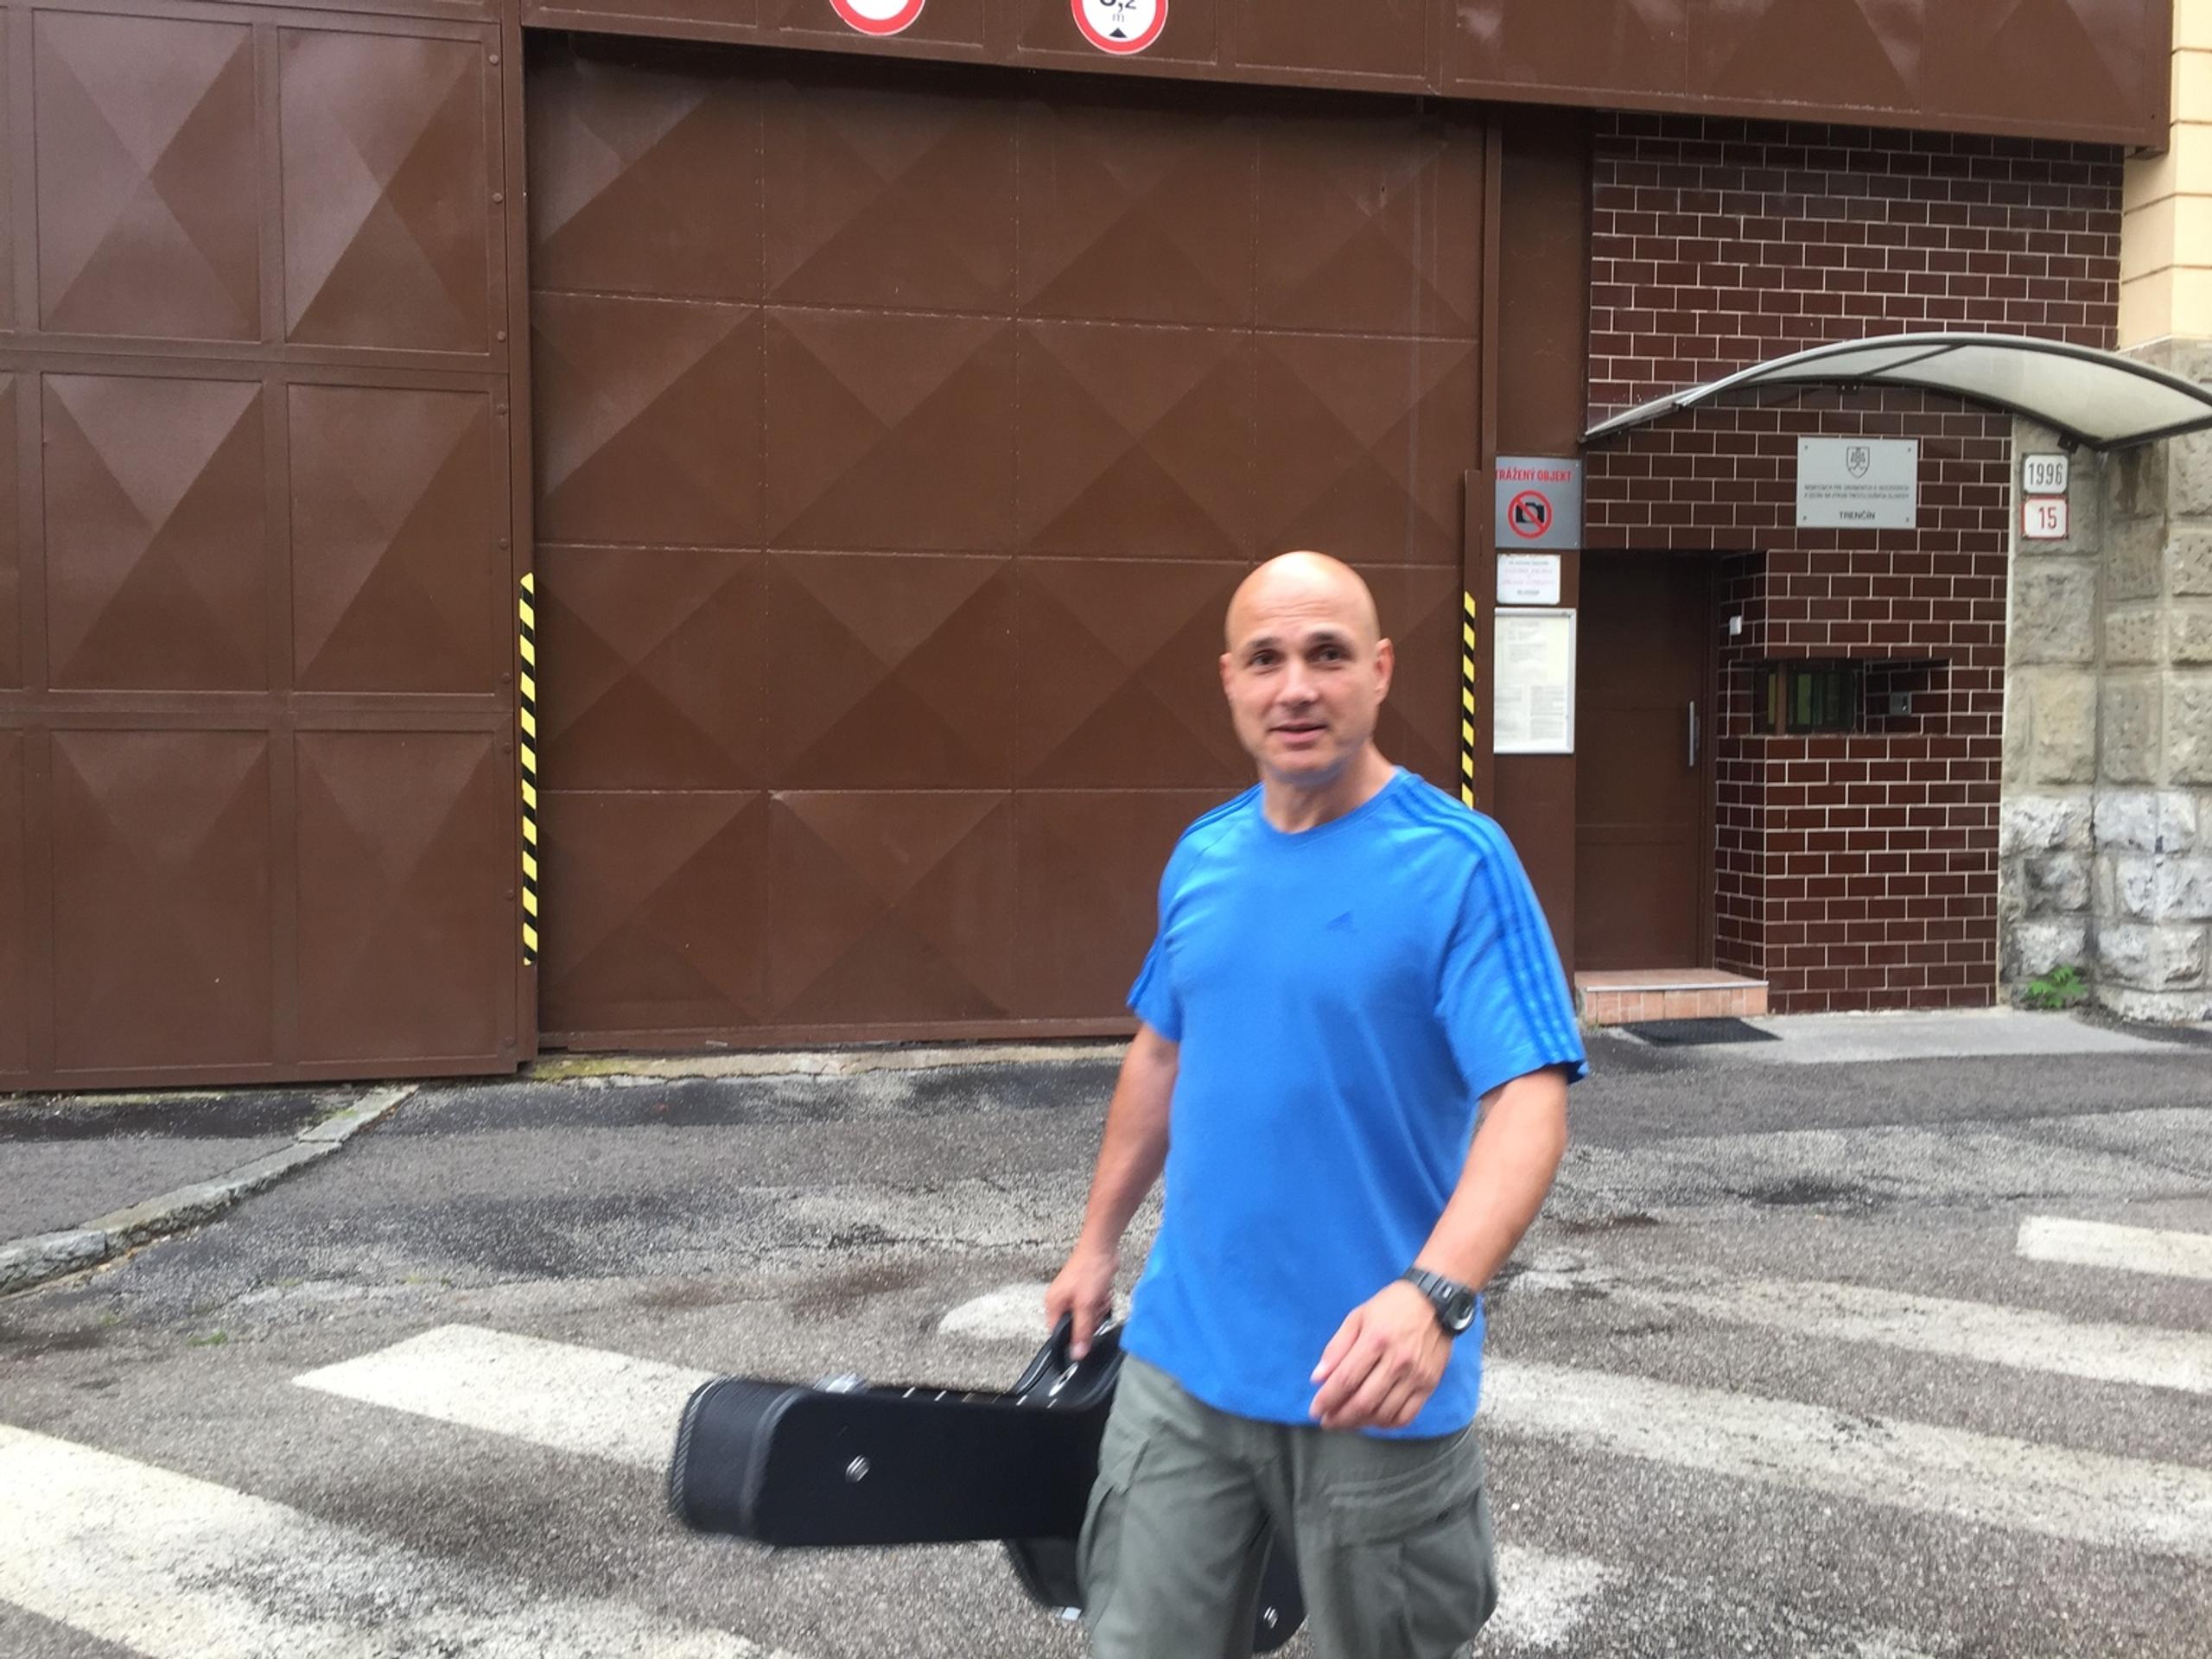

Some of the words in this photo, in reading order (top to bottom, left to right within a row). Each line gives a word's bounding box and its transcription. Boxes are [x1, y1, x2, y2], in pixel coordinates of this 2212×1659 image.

[1537, 469, 1572, 482] OBJEKT
[2028, 462, 2063, 486] 1996
[2039, 506, 2057, 530] 15
